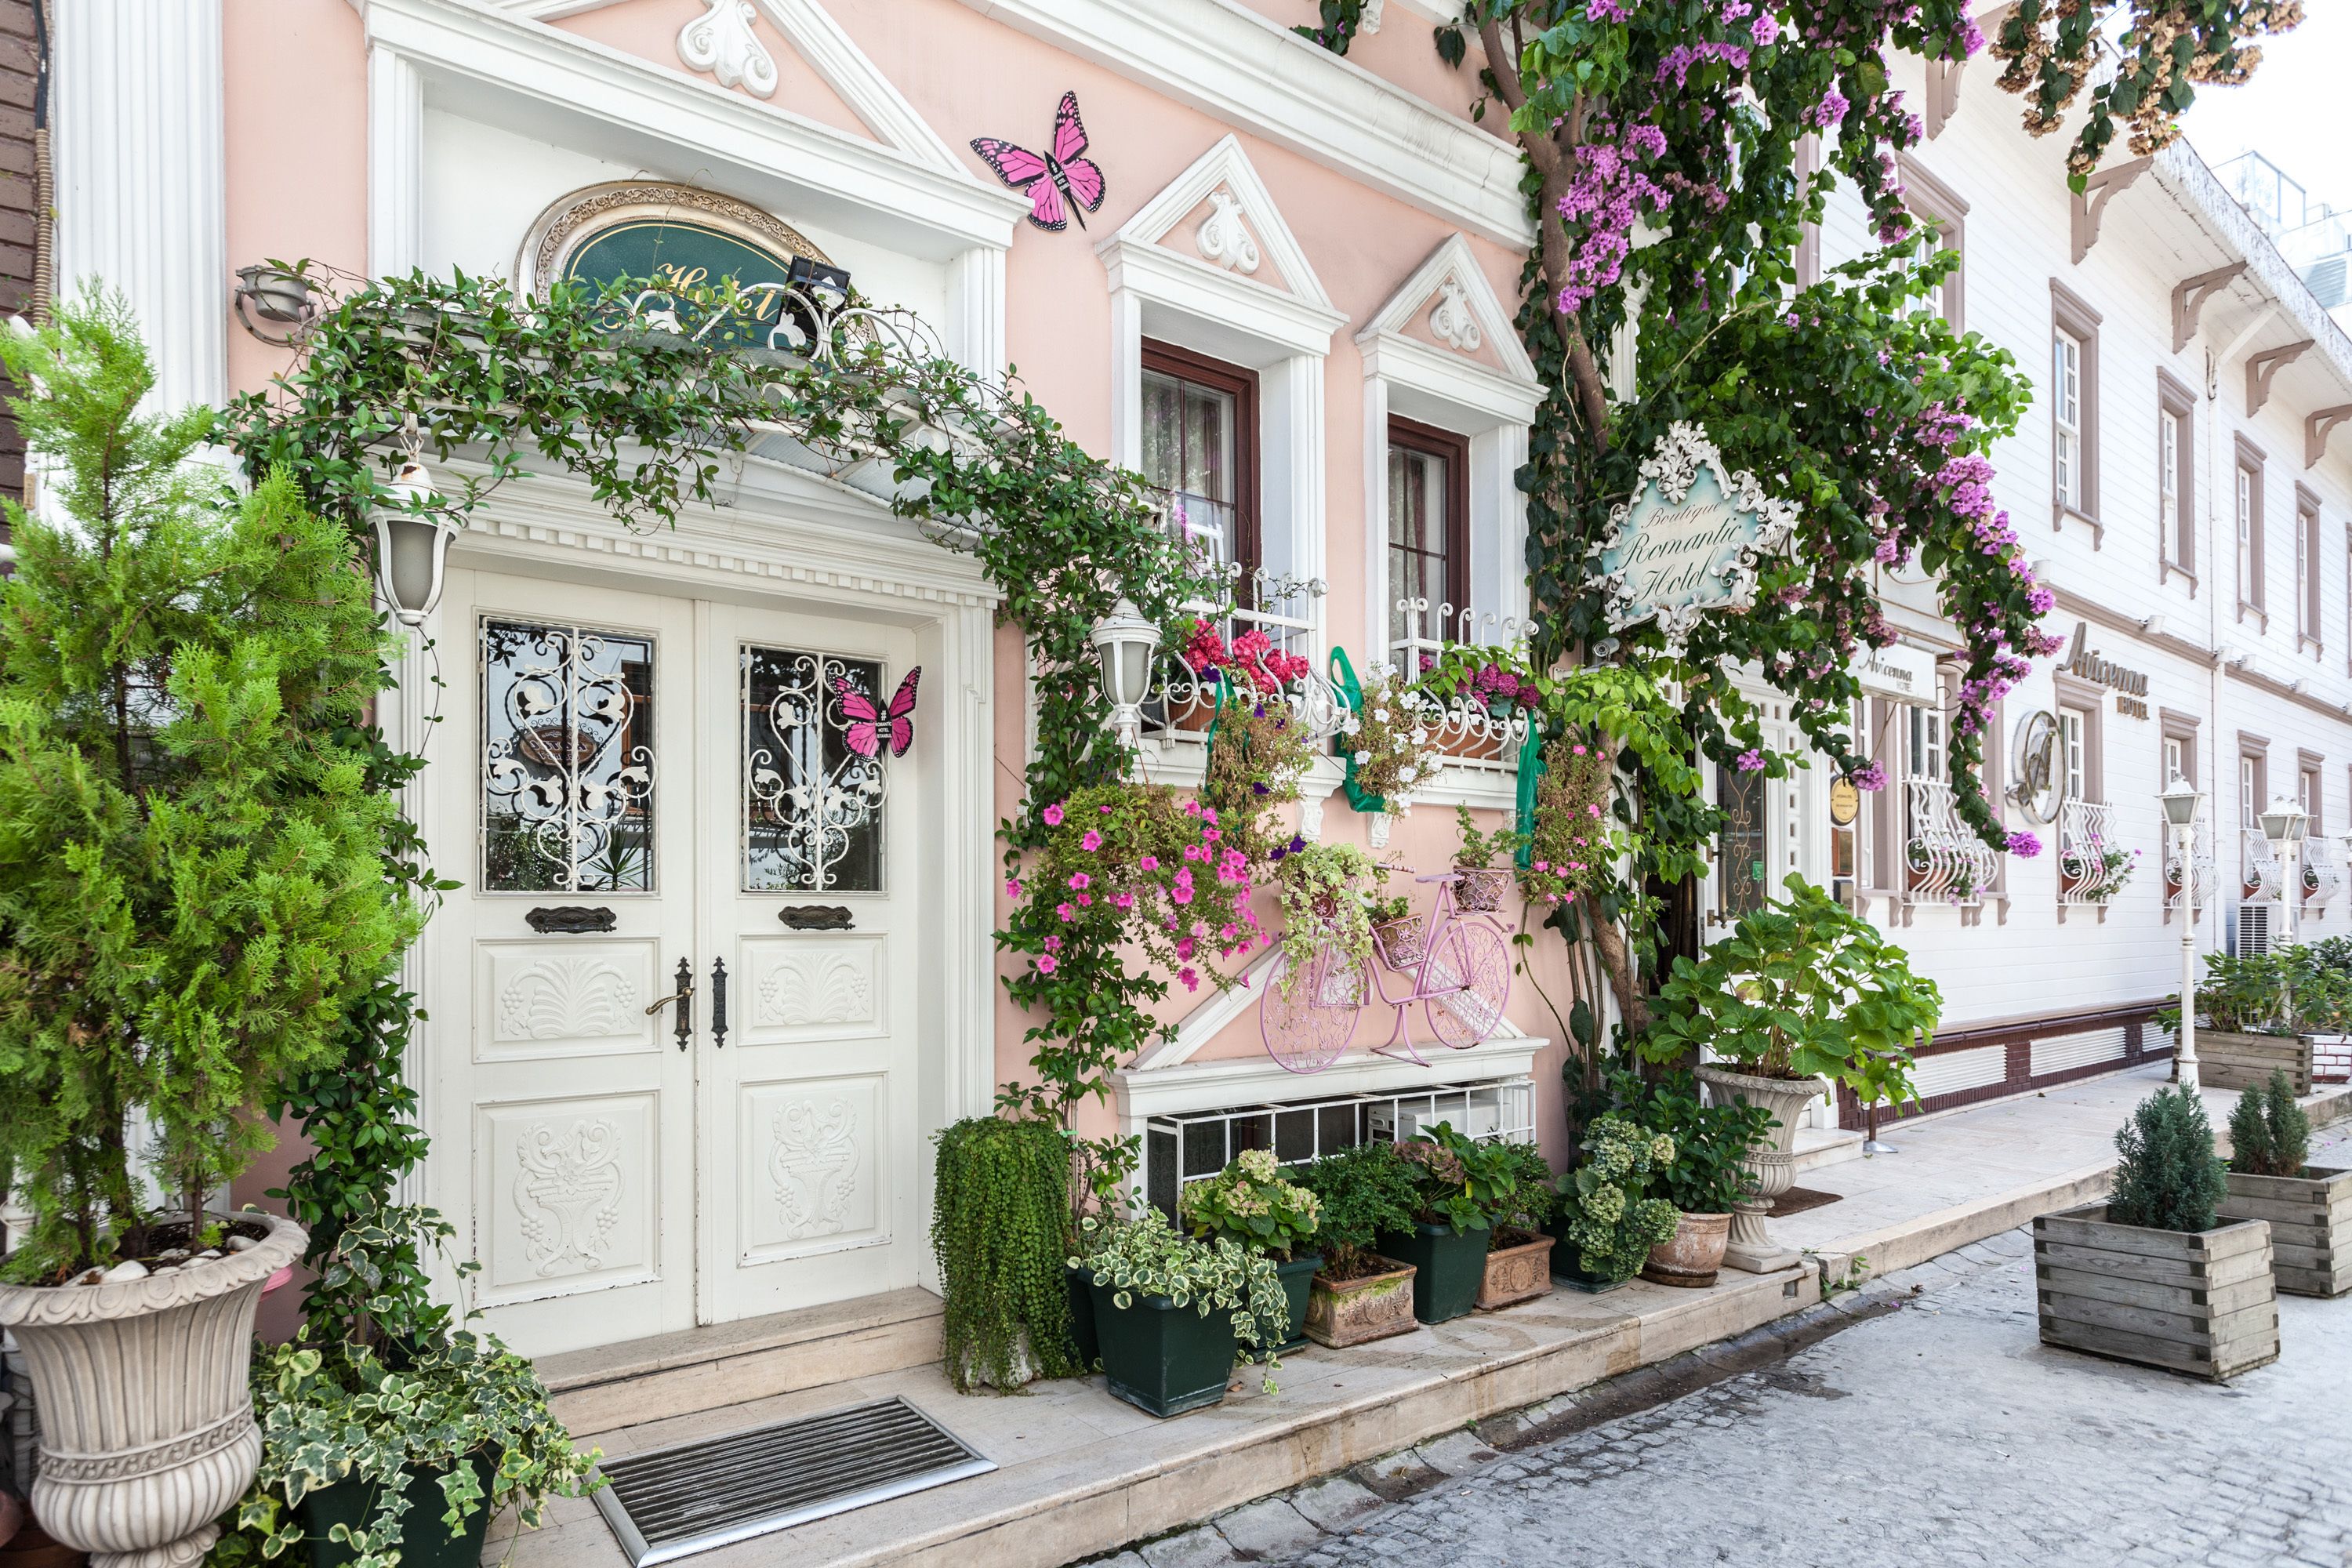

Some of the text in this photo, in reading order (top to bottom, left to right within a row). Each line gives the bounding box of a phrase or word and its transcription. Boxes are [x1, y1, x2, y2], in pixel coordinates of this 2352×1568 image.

[648, 263, 778, 321] Hoel
[1640, 502, 1722, 529] Boutique
[1614, 517, 1742, 570] Romantic
[1635, 546, 1719, 603] Hotel
[1858, 651, 1913, 682] Avicenna
[2055, 622, 2149, 697] Avicenna
[2116, 696, 2150, 720] HOTEL
